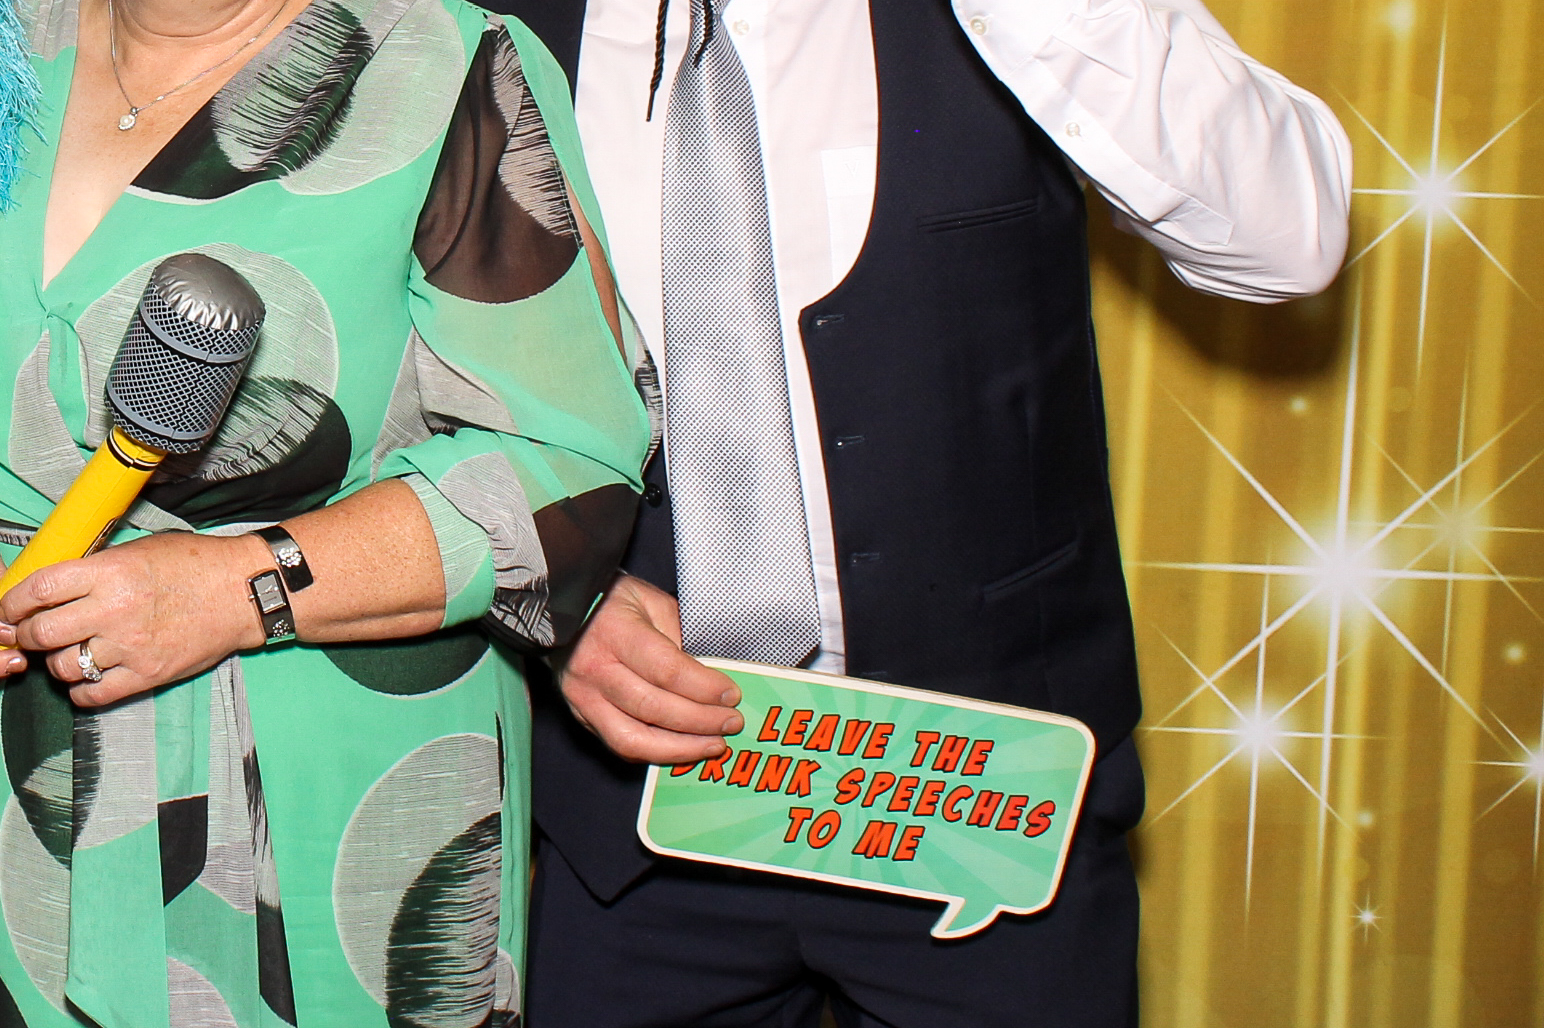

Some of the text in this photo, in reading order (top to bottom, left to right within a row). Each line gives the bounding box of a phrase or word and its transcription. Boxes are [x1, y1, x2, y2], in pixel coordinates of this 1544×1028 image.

[757, 706, 995, 777] LEAVE THE
[783, 806, 926, 862] TO ME
[834, 767, 1057, 838] SPEECHES
